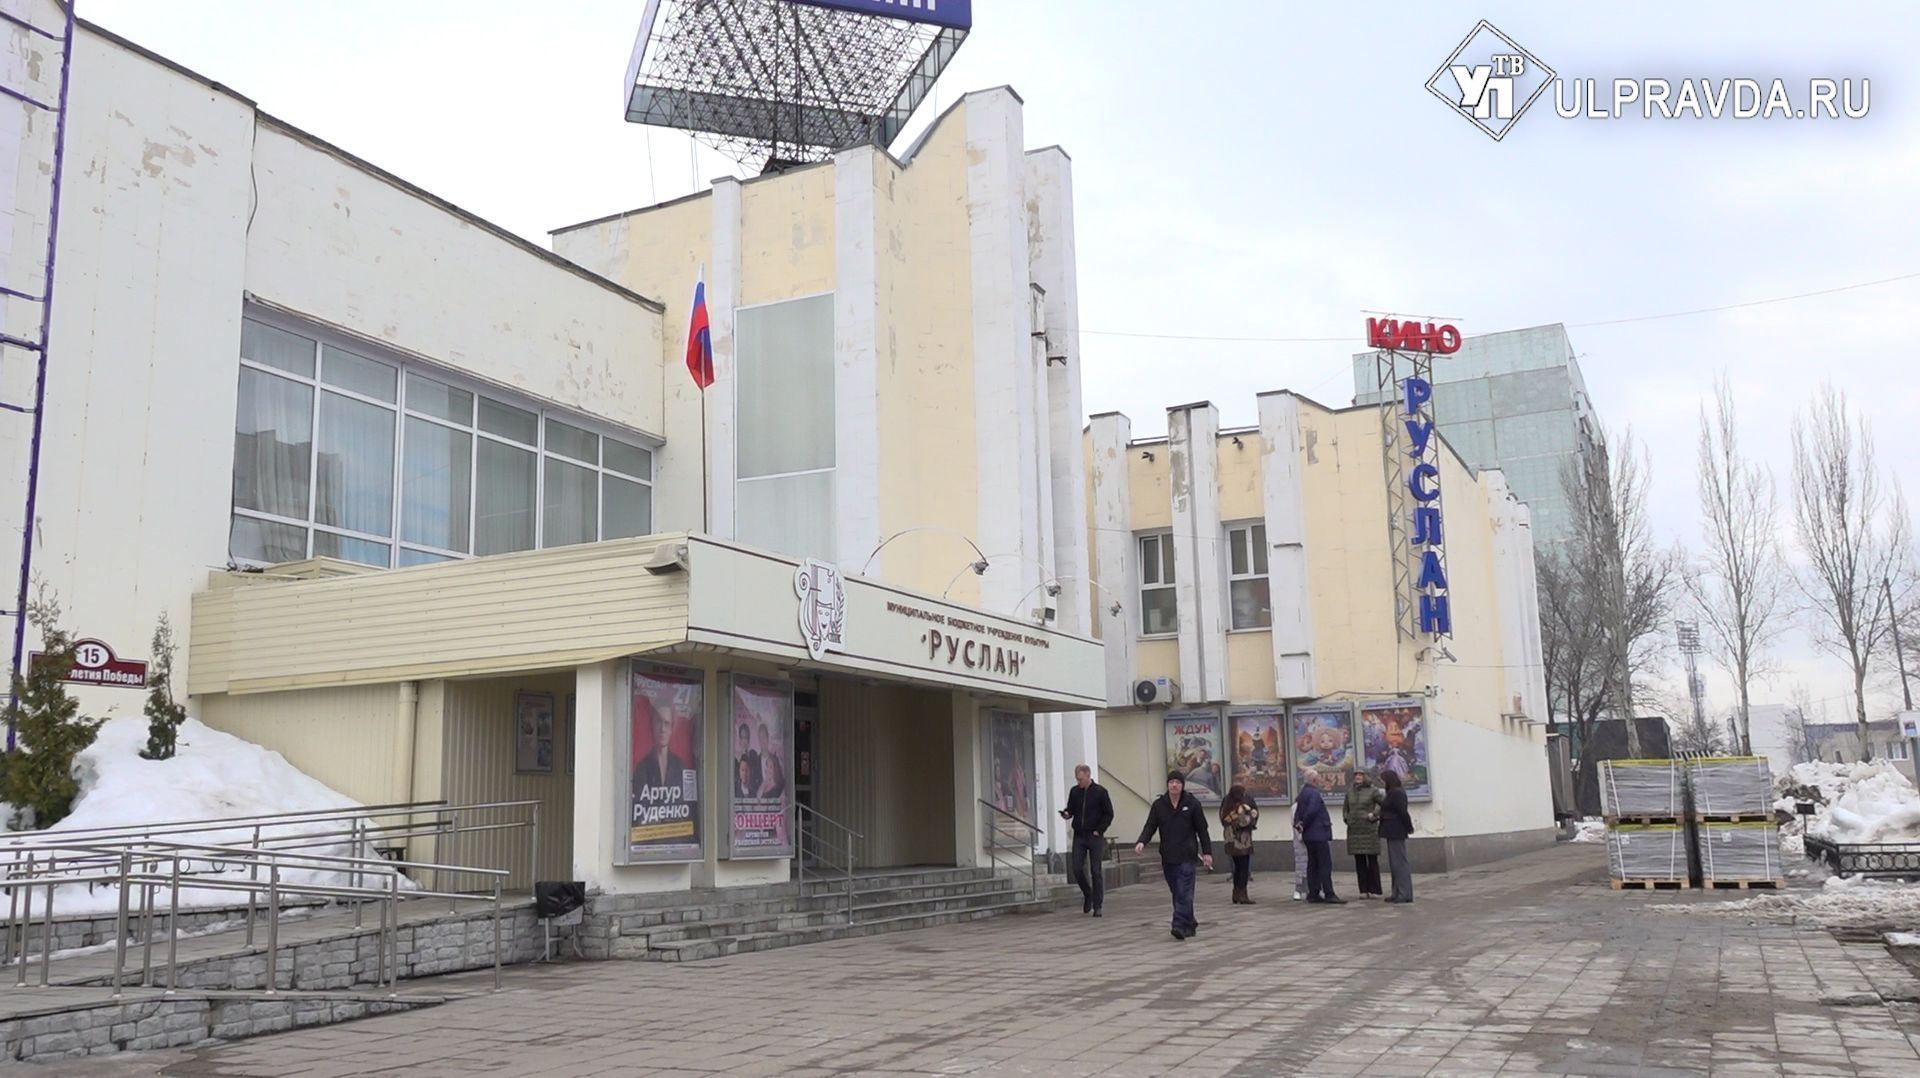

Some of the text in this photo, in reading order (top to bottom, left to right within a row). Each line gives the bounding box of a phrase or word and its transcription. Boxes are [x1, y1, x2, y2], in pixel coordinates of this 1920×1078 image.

[1366, 317, 1462, 354] КИНО
[1404, 376, 1450, 634] РУСЛАН
[886, 601, 945, 625] МУНИЦИПАЛЬНОЕ
[947, 616, 986, 634] БЮДЖЕТНОЕ
[987, 626, 1023, 643] УЧРЕЖДЕНИЕ
[83, 648, 100, 665] 15
[103, 669, 143, 684] Победы
[1174, 723, 1212, 736] ЖДУН
[640, 783, 681, 805] Артур
[633, 803, 690, 825] Руденко
[736, 813, 785, 830] ОНЦЕРТ
